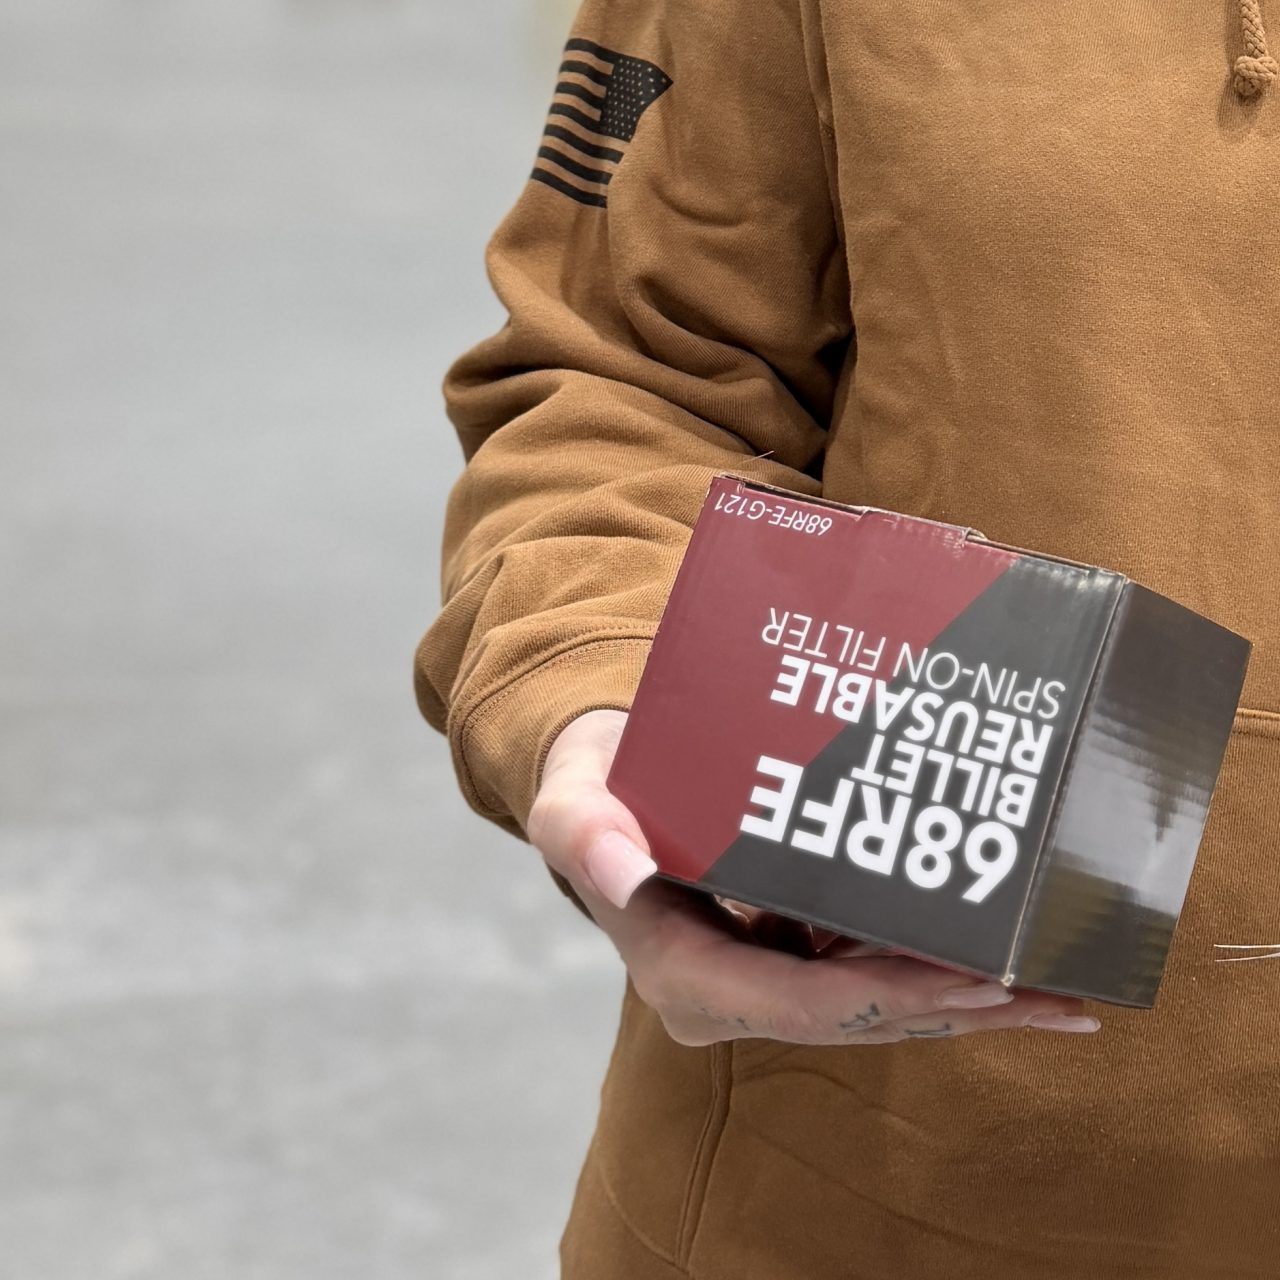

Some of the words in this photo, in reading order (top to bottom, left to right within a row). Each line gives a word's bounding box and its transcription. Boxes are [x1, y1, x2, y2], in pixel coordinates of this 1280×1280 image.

[714, 492, 833, 536] 68RFE-G121
[760, 607, 887, 672] FILTER
[893, 642, 1066, 719] SPIN-ON
[769, 654, 1054, 775] REUSABLE
[850, 733, 1038, 828] BILLET
[739, 754, 1018, 904] 68RFE
